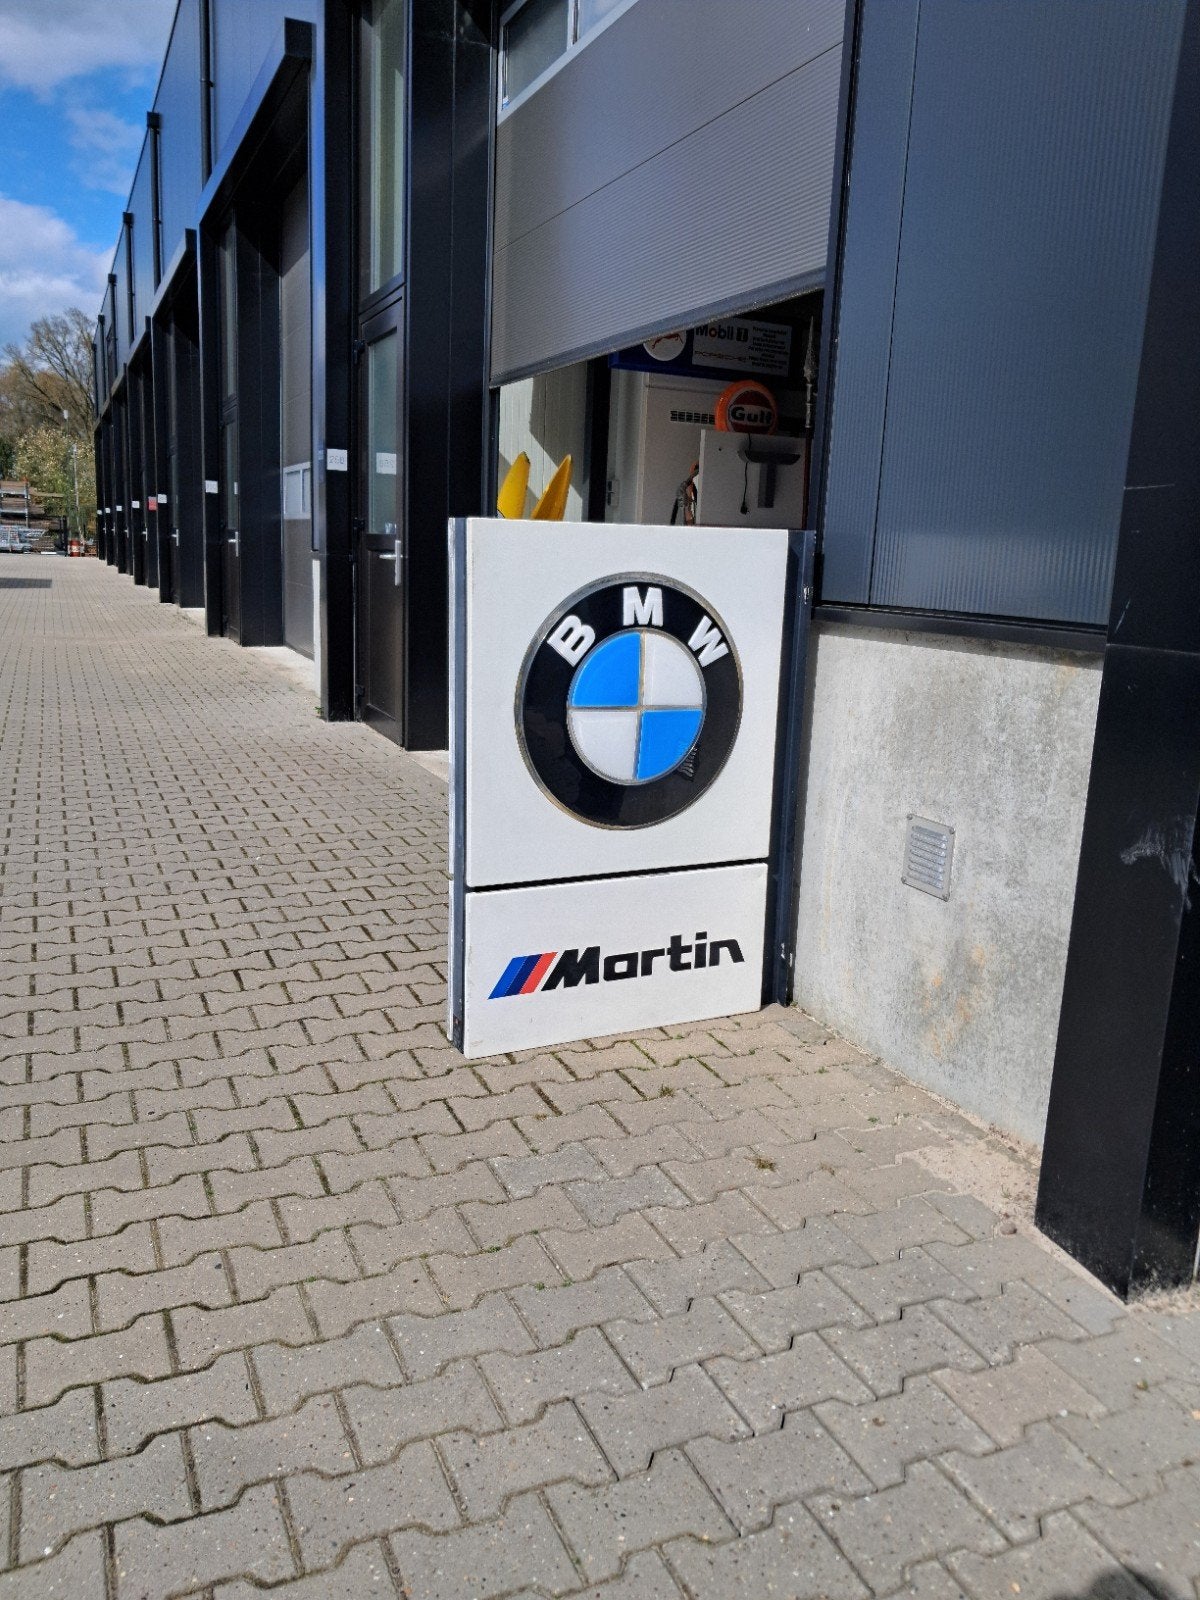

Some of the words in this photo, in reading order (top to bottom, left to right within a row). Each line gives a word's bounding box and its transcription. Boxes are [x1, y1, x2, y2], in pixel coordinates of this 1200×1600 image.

[695, 325, 733, 341] Mobil
[737, 327, 748, 342] 1
[731, 407, 772, 425] Gulf
[547, 586, 729, 668] BMW
[541, 931, 745, 992] Martin
